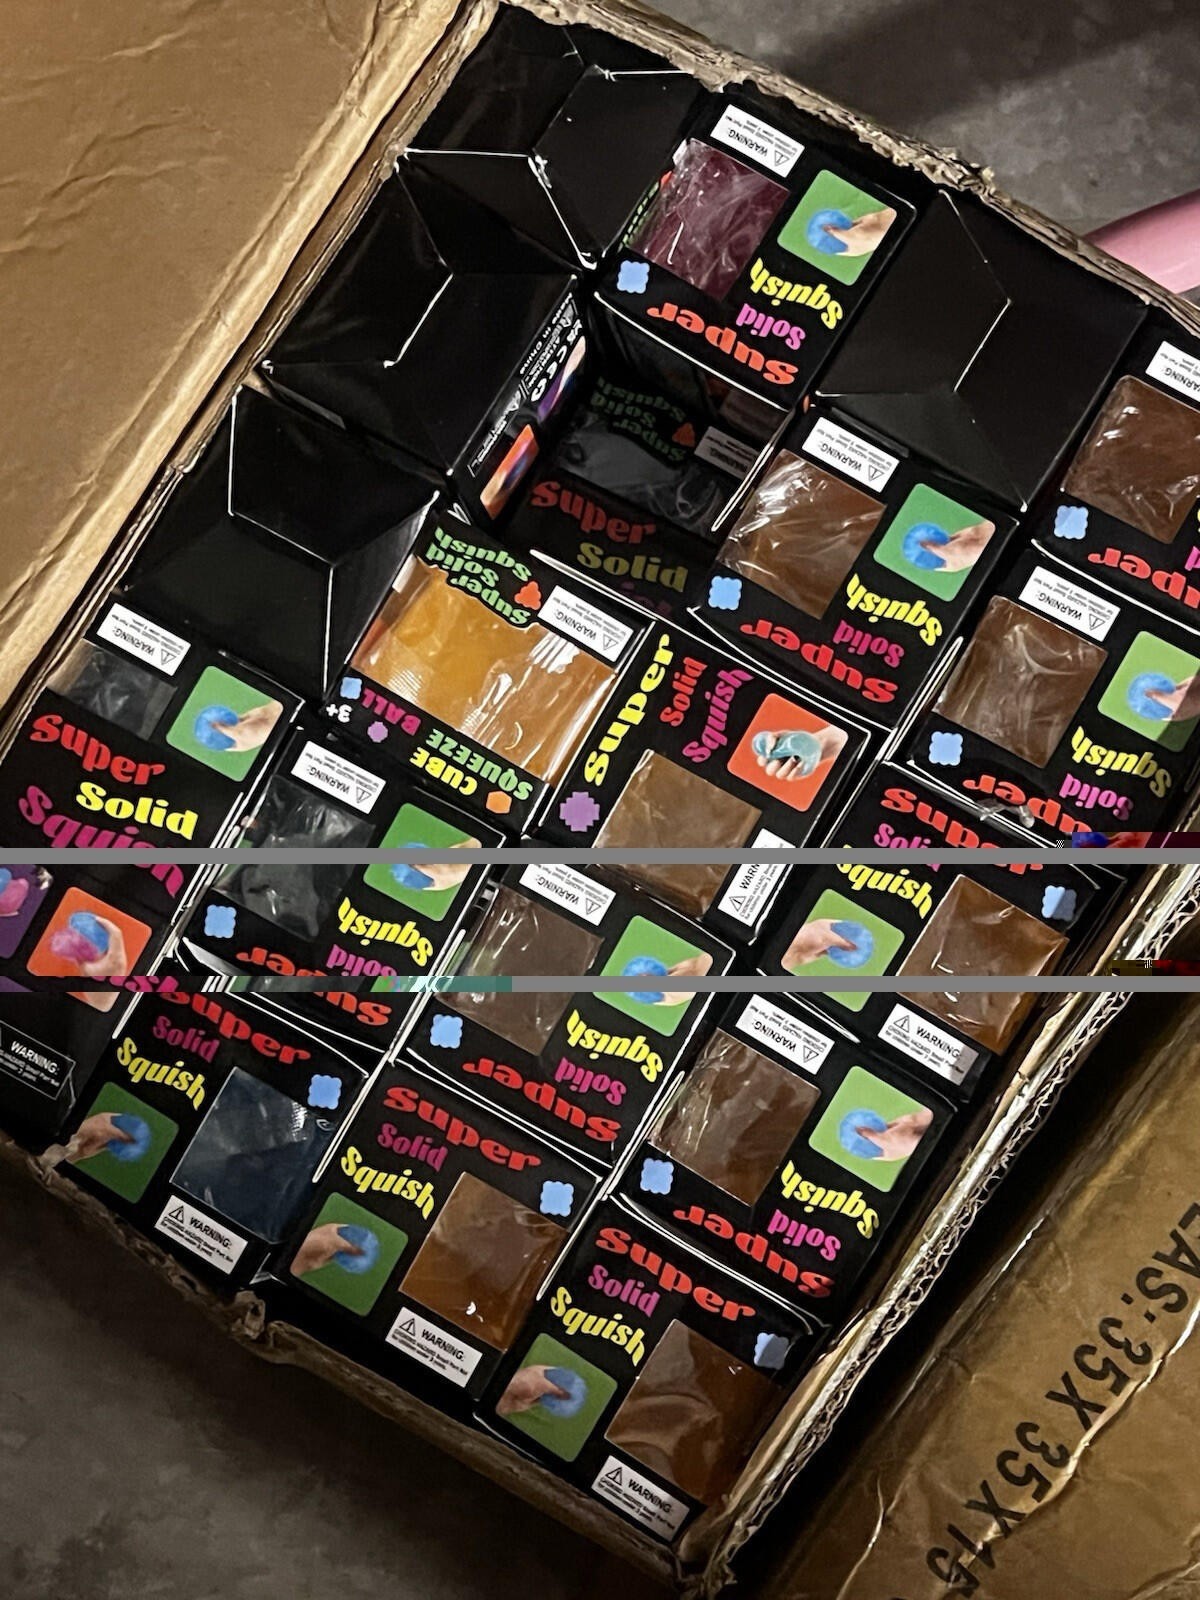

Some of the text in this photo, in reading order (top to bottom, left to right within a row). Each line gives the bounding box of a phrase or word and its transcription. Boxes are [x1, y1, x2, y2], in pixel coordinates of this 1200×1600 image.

[735, 303, 806, 350] Solid
[750, 258, 843, 329] Squish
[647, 302, 799, 385] Super
[530, 480, 656, 544] Super
[425, 543, 500, 588] Solid
[435, 526, 533, 583] Squish
[577, 542, 688, 592] Solid
[1088, 547, 1200, 610] per
[450, 574, 532, 625] Super
[846, 573, 942, 646] Squish
[740, 619, 898, 703] Super
[833, 620, 904, 668] Solid
[326, 703, 353, 723] 3+
[361, 687, 421, 736] BALL
[584, 634, 674, 786] Super
[659, 656, 708, 726] Solid
[682, 669, 754, 762] Squish
[30, 714, 165, 785] Super
[409, 747, 478, 795] CUBE
[425, 729, 534, 800] SQUEEZE
[1071, 726, 1172, 798] Squish
[76, 781, 198, 840] Solid
[962, 774, 1093, 832] uper
[1059, 773, 1133, 820] Solid
[338, 897, 433, 967] Squish
[236, 947, 392, 1026] Suer
[117, 1037, 207, 1111] Squish
[152, 1015, 220, 1063] Solid
[566, 1009, 663, 1082] Squish
[462, 1058, 621, 1142] Super
[554, 1057, 627, 1106] Solid
[377, 1122, 448, 1172] Solid
[383, 1086, 542, 1171] Super
[341, 1145, 435, 1220] Squish
[780, 1160, 879, 1239] Squish
[673, 1206, 835, 1298] Super
[767, 1209, 841, 1262] Solid
[588, 1264, 660, 1318] Solid
[596, 1227, 756, 1322] Super
[550, 1286, 645, 1367] Squish
